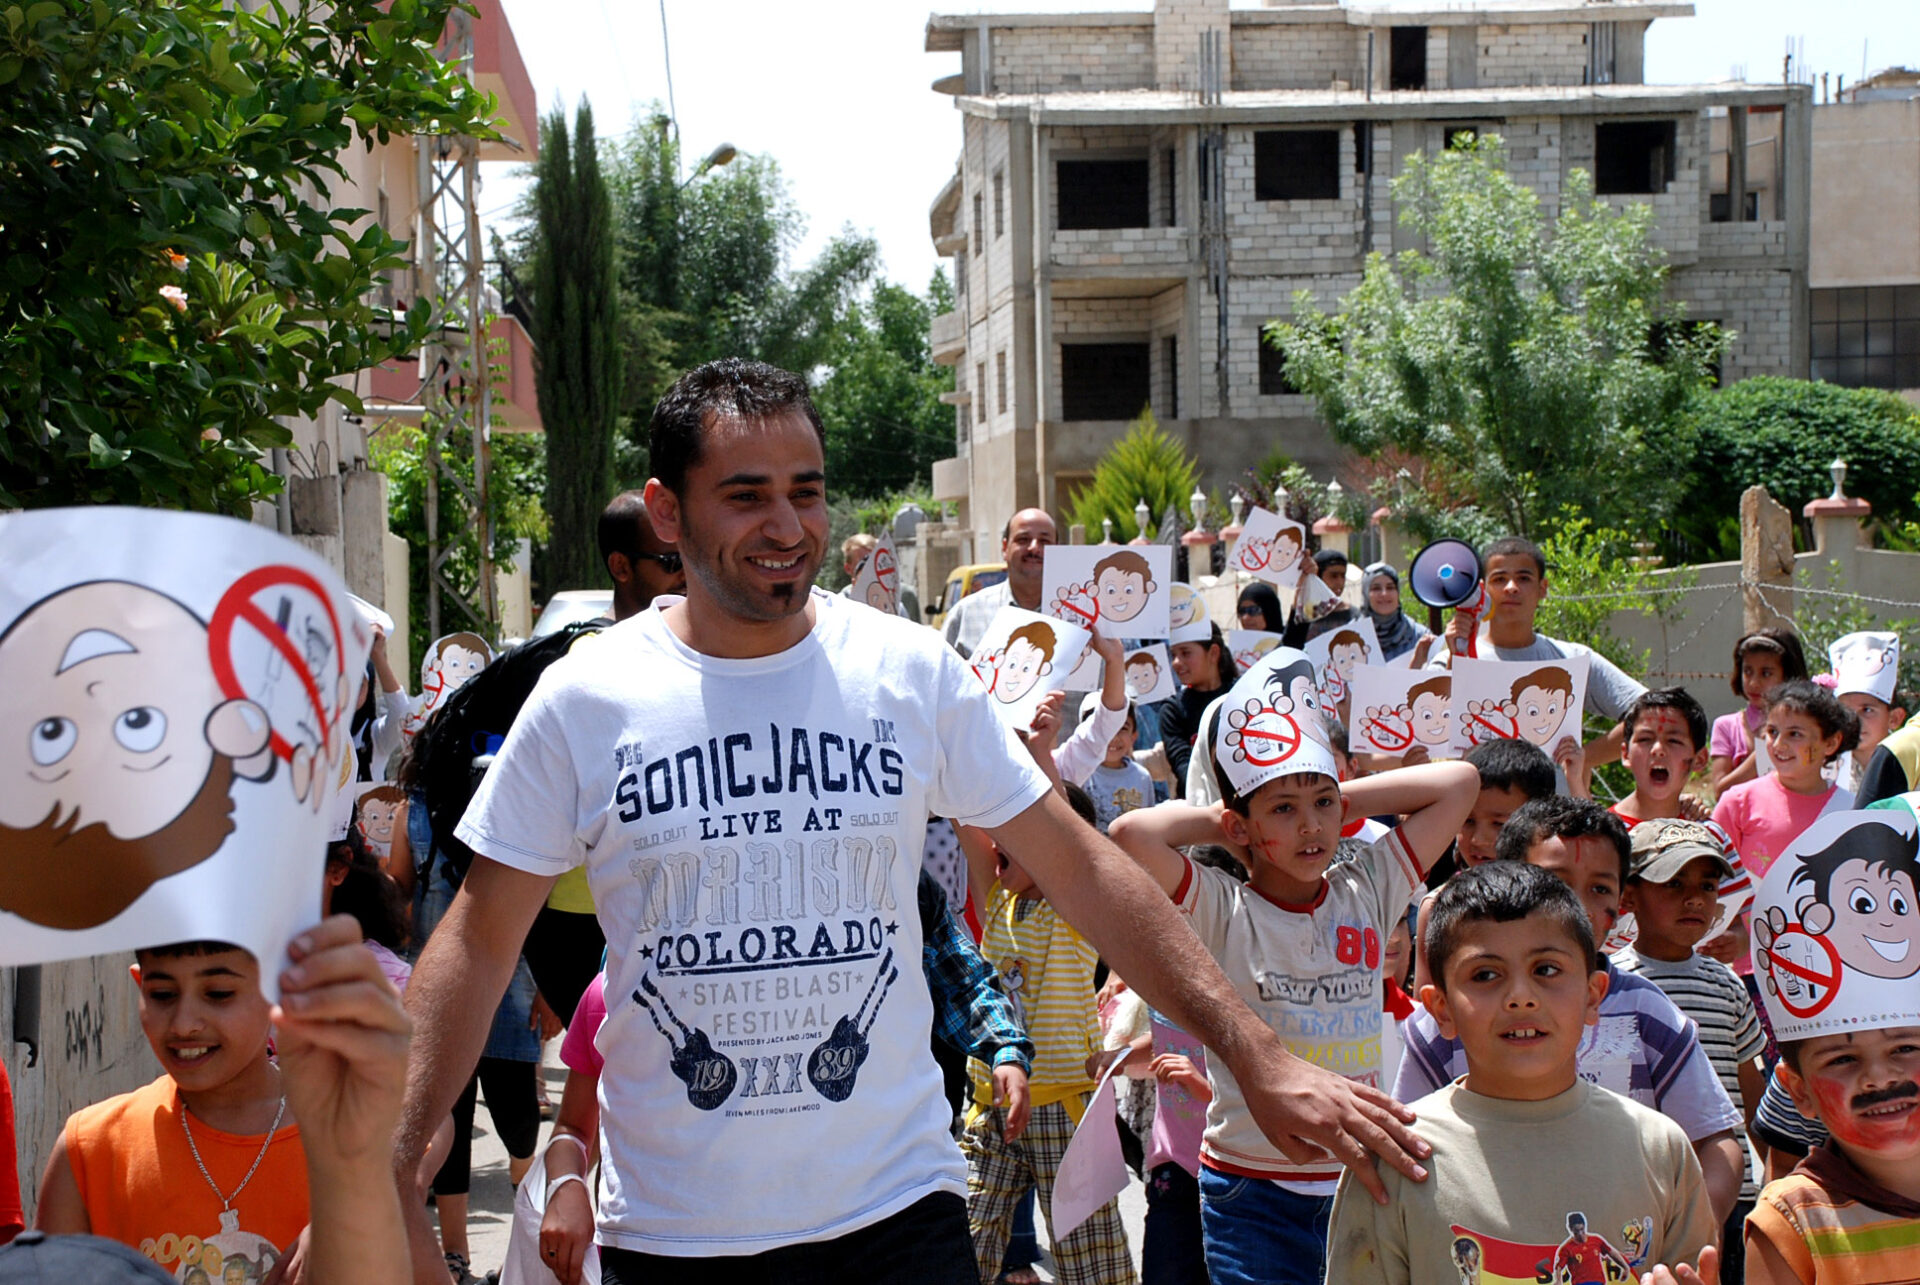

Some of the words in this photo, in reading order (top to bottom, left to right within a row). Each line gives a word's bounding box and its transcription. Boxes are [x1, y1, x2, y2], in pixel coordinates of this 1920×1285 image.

[616, 723, 904, 823] SONICJACKS
[663, 825, 687, 842] OUT
[699, 809, 782, 841] LIVE
[802, 807, 843, 832] AT
[657, 917, 883, 970] COLORADO
[1336, 925, 1379, 970] 89
[693, 977, 766, 1006] STATE
[775, 970, 853, 999] BLAST
[1259, 974, 1315, 1004] NEW
[1321, 971, 1373, 1002] YORK
[712, 1005, 830, 1036] FESTIVAL
[766, 1036, 784, 1044] JACK
[801, 1031, 822, 1040] JONES
[690, 1059, 729, 1092] 19
[739, 1052, 804, 1098] XXX
[813, 1047, 856, 1082] 89
[1575, 1253, 1583, 1264] 9
